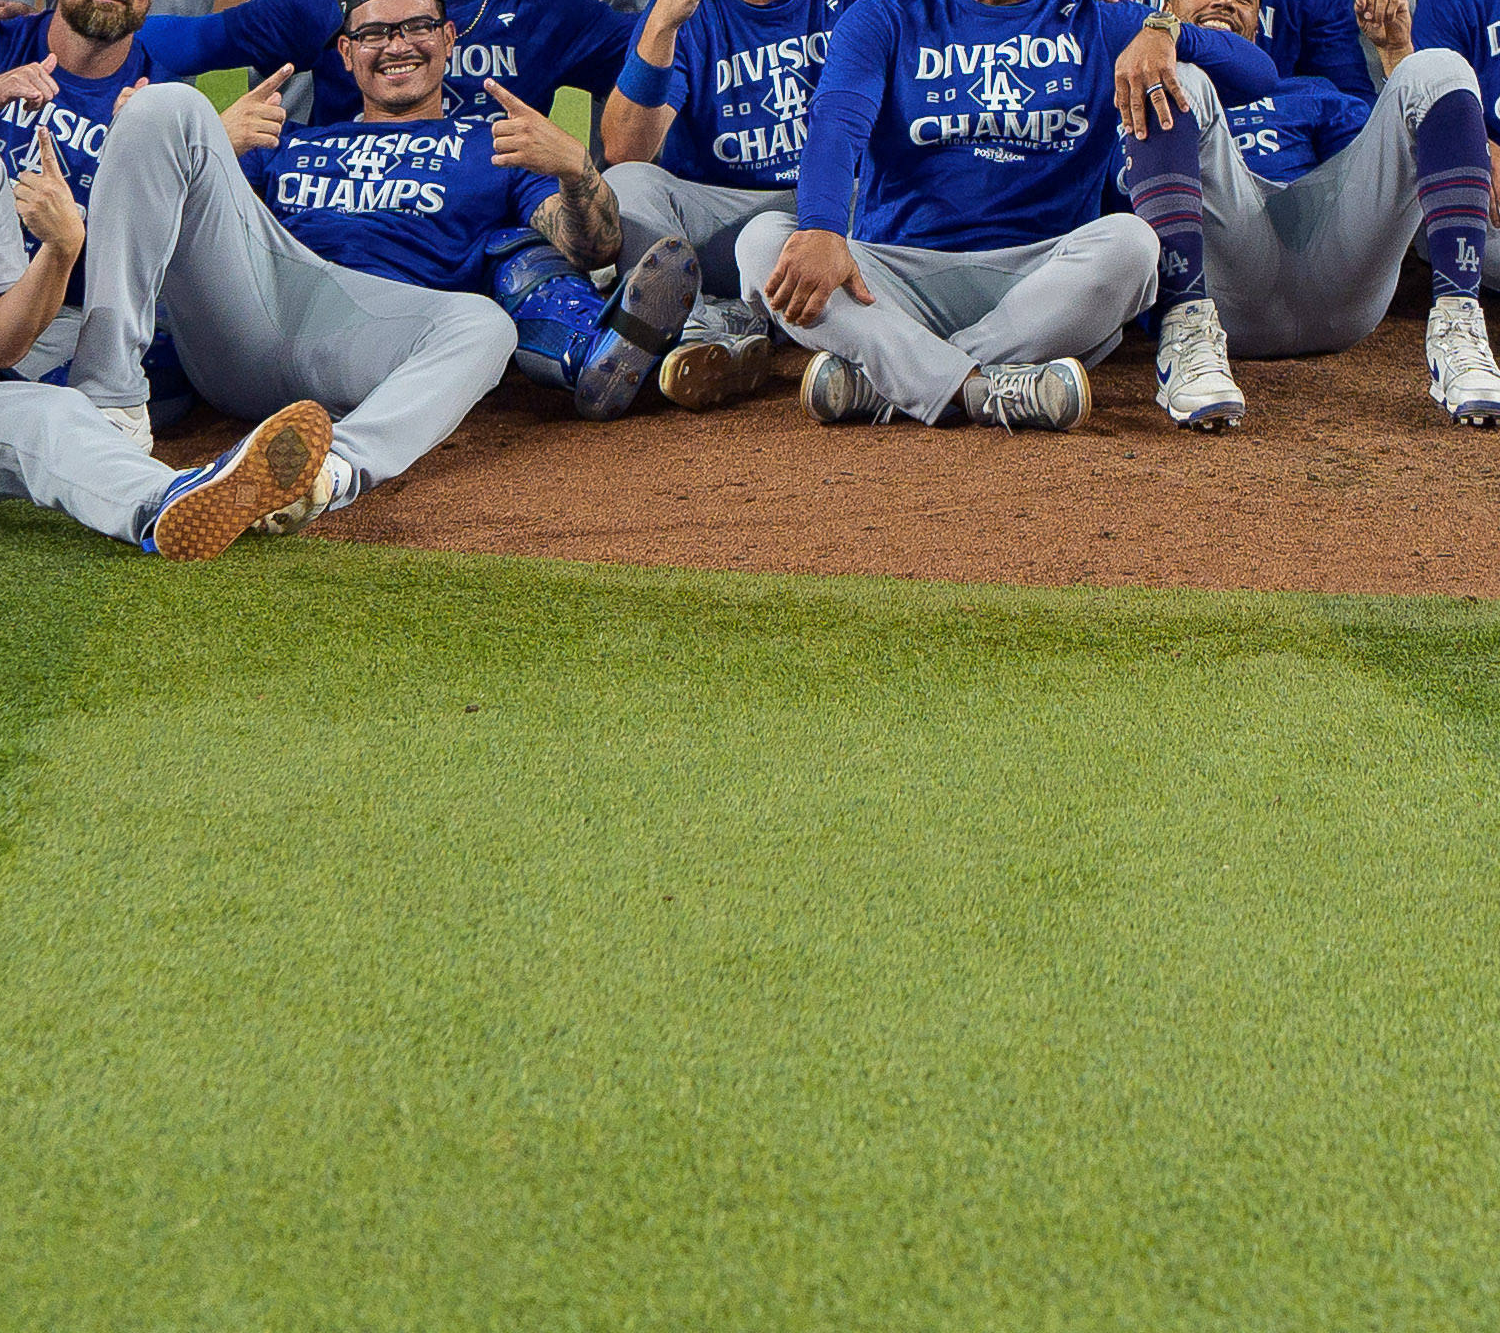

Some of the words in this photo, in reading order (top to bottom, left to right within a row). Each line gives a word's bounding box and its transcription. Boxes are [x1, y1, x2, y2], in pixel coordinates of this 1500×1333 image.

[915, 33, 1083, 82] DIVISION
[925, 89, 957, 104] 20
[1044, 75, 1075, 93] 25
[908, 105, 1091, 147] CHAMPS
